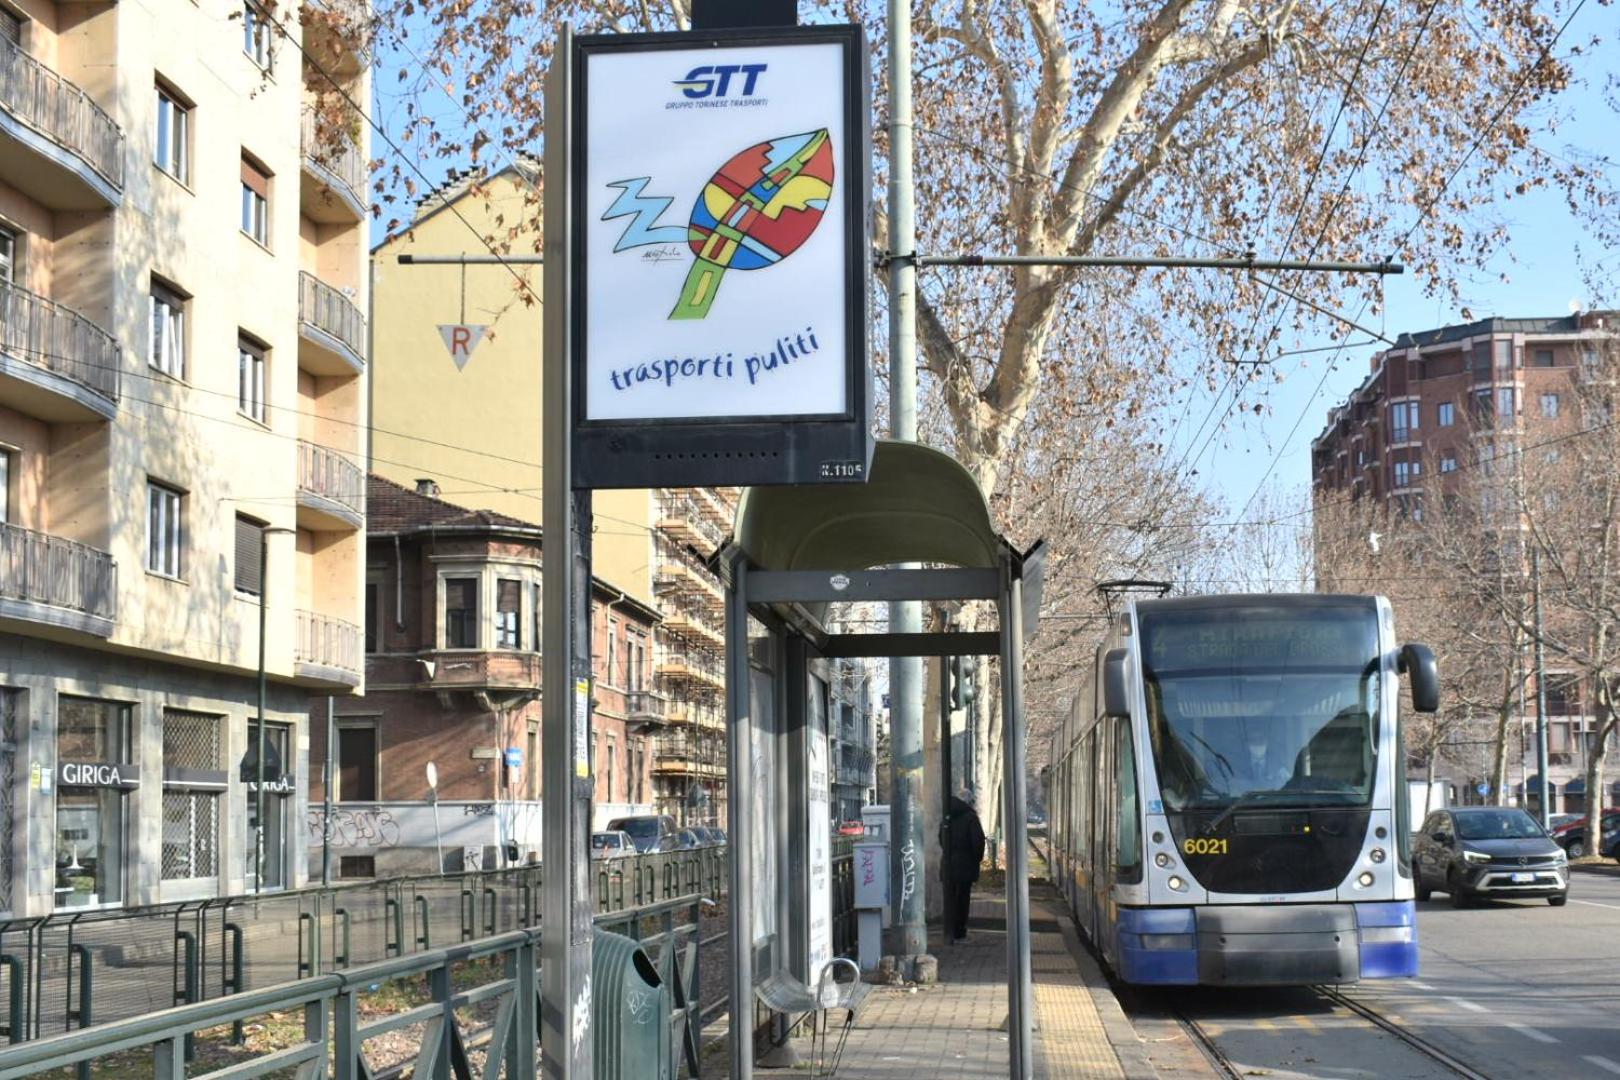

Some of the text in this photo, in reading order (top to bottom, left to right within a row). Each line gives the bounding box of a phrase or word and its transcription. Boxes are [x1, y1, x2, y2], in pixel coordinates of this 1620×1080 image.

[671, 63, 768, 99] GTT
[665, 98, 769, 110] GRUPPO TORINESE TRASPORTI
[452, 326, 471, 355] R
[610, 326, 819, 391] trasporti puliti
[62, 763, 121, 785] GIRIGA
[1183, 838, 1228, 854] 6021
